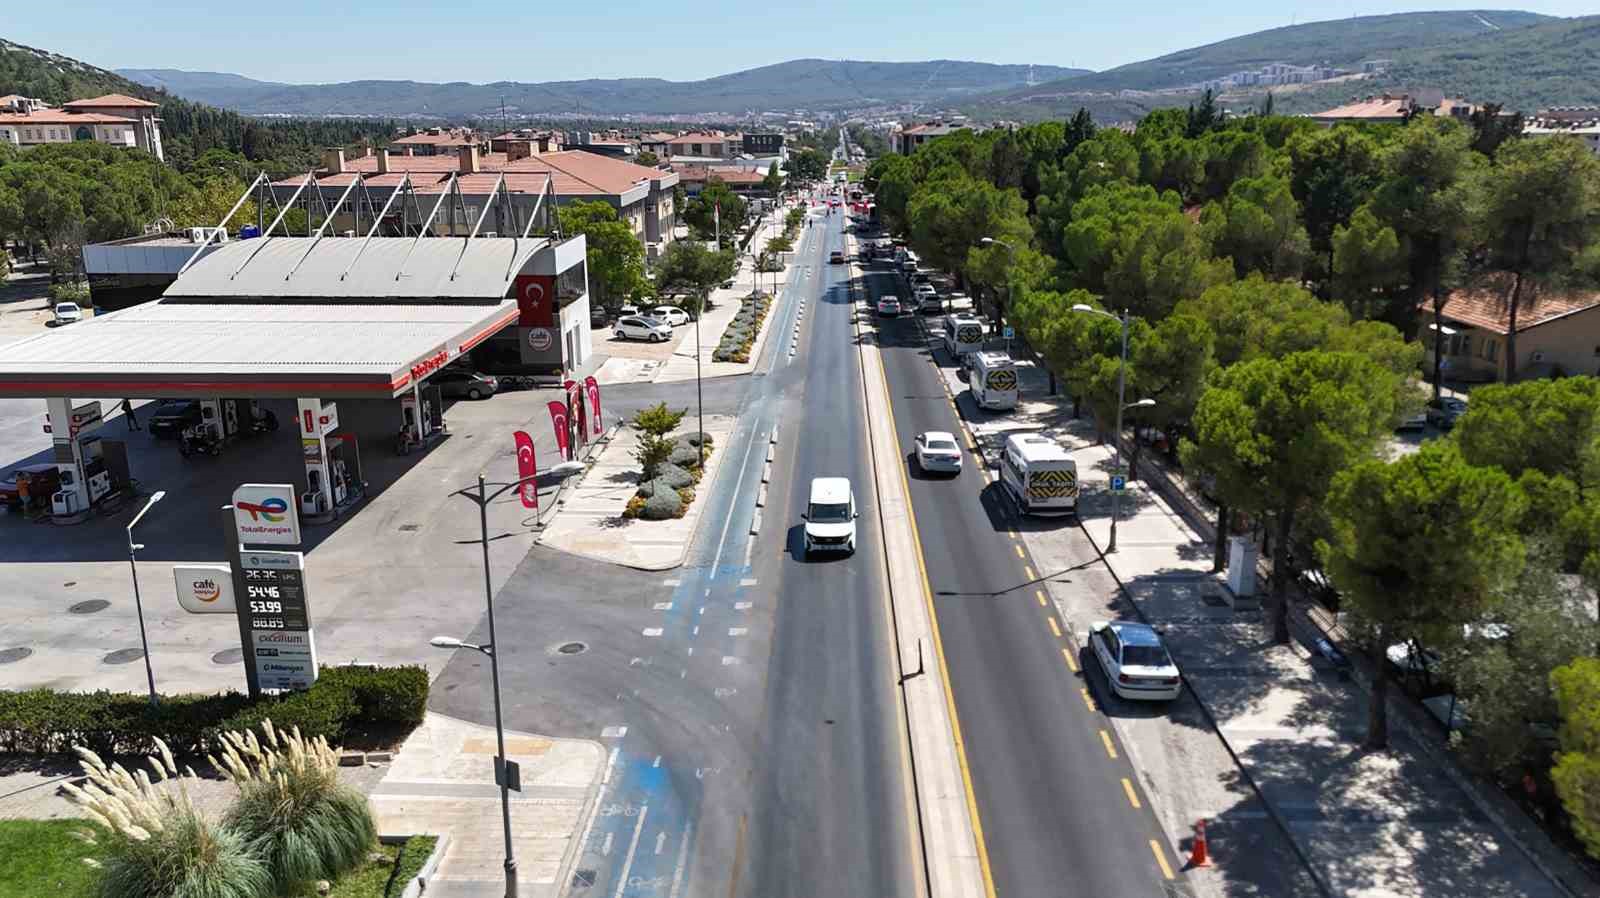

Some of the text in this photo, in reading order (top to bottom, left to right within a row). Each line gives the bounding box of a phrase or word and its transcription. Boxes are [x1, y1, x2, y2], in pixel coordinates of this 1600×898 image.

[241, 526, 292, 535] TotalEnergies
[193, 578, 215, 589] café
[248, 586, 280, 598] 54.46
[250, 601, 283, 613] 53.99
